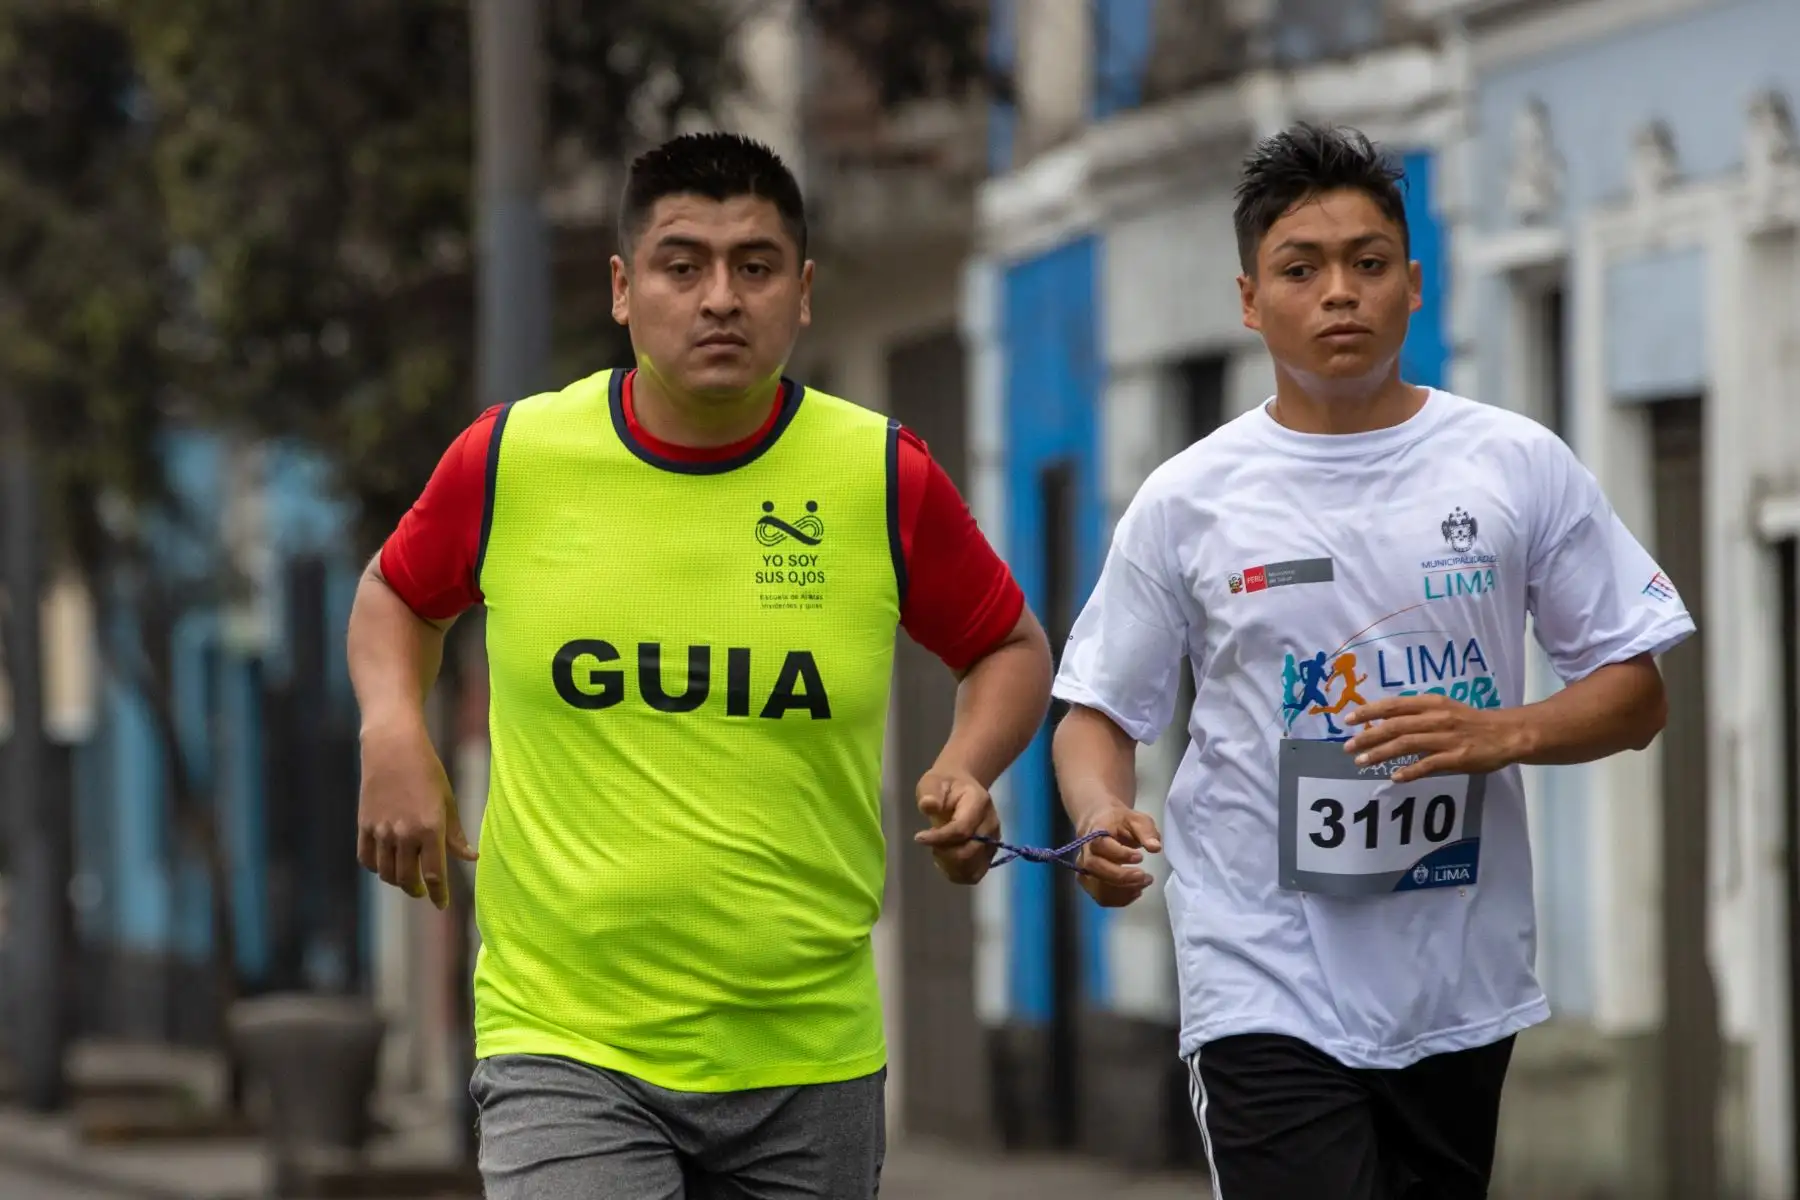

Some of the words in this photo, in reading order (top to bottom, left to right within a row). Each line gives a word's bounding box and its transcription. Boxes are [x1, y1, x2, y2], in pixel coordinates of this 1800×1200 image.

[763, 554, 783, 567] YO
[788, 554, 818, 567] SOY
[755, 571, 784, 583] SUS
[788, 571, 825, 586] OJOS
[1424, 569, 1496, 600] LIMA
[1378, 638, 1488, 688] LIMA
[552, 639, 832, 720] GUIA
[1309, 795, 1456, 849] 3110
[1435, 868, 1470, 882] LIMA
